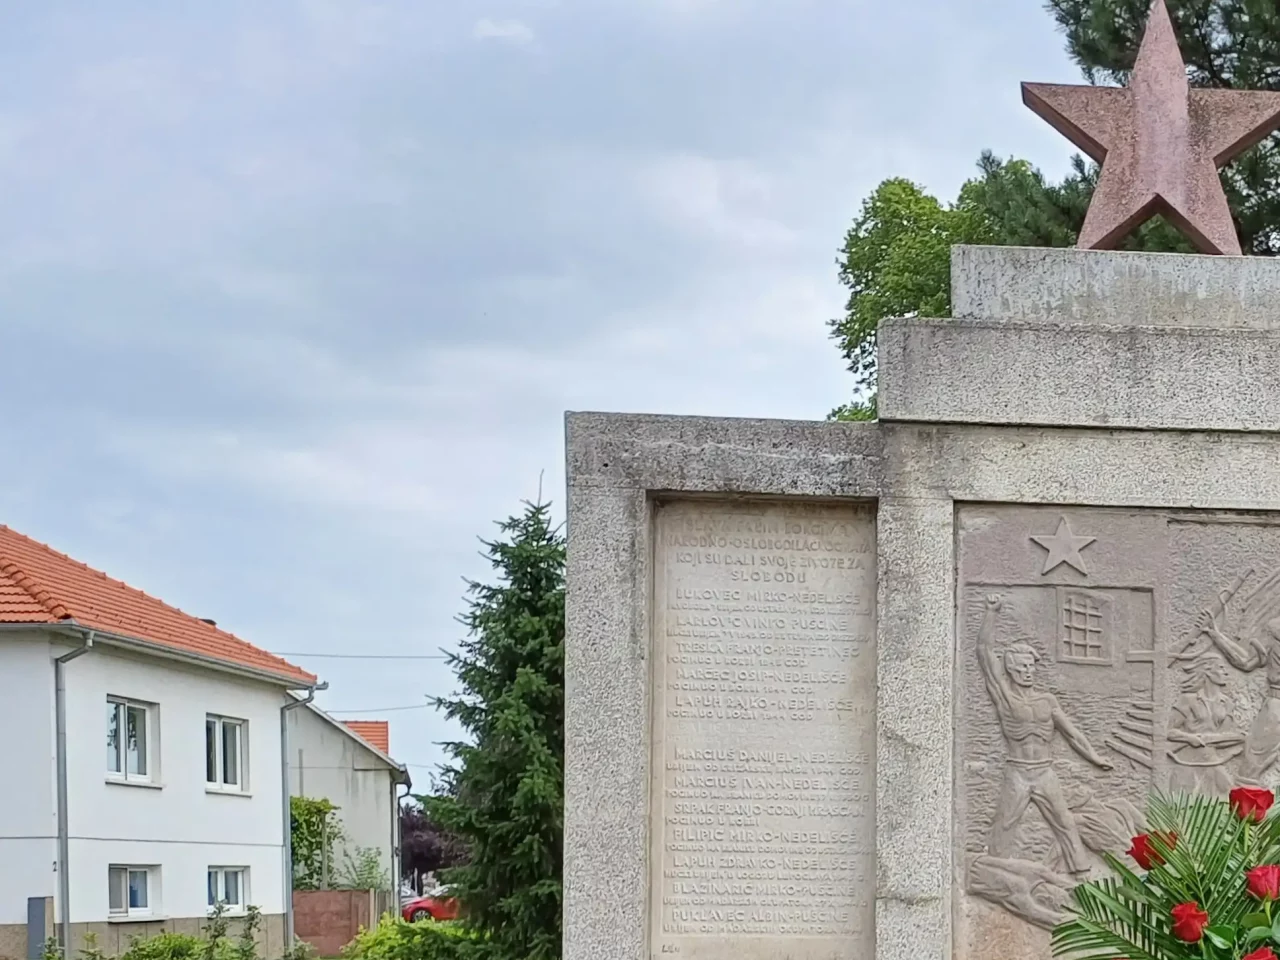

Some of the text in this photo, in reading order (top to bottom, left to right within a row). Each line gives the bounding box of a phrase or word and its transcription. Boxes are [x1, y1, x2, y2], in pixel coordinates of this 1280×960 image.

[676, 552, 702, 568] KOJI
[705, 553, 721, 565] SU
[725, 554, 755, 566] DALI
[759, 555, 796, 570] SVOJE
[846, 558, 865, 570] ZA
[731, 570, 806, 584] SLOBODU
[674, 802, 714, 815] SRPAK
[673, 855, 716, 869] LAPUH
